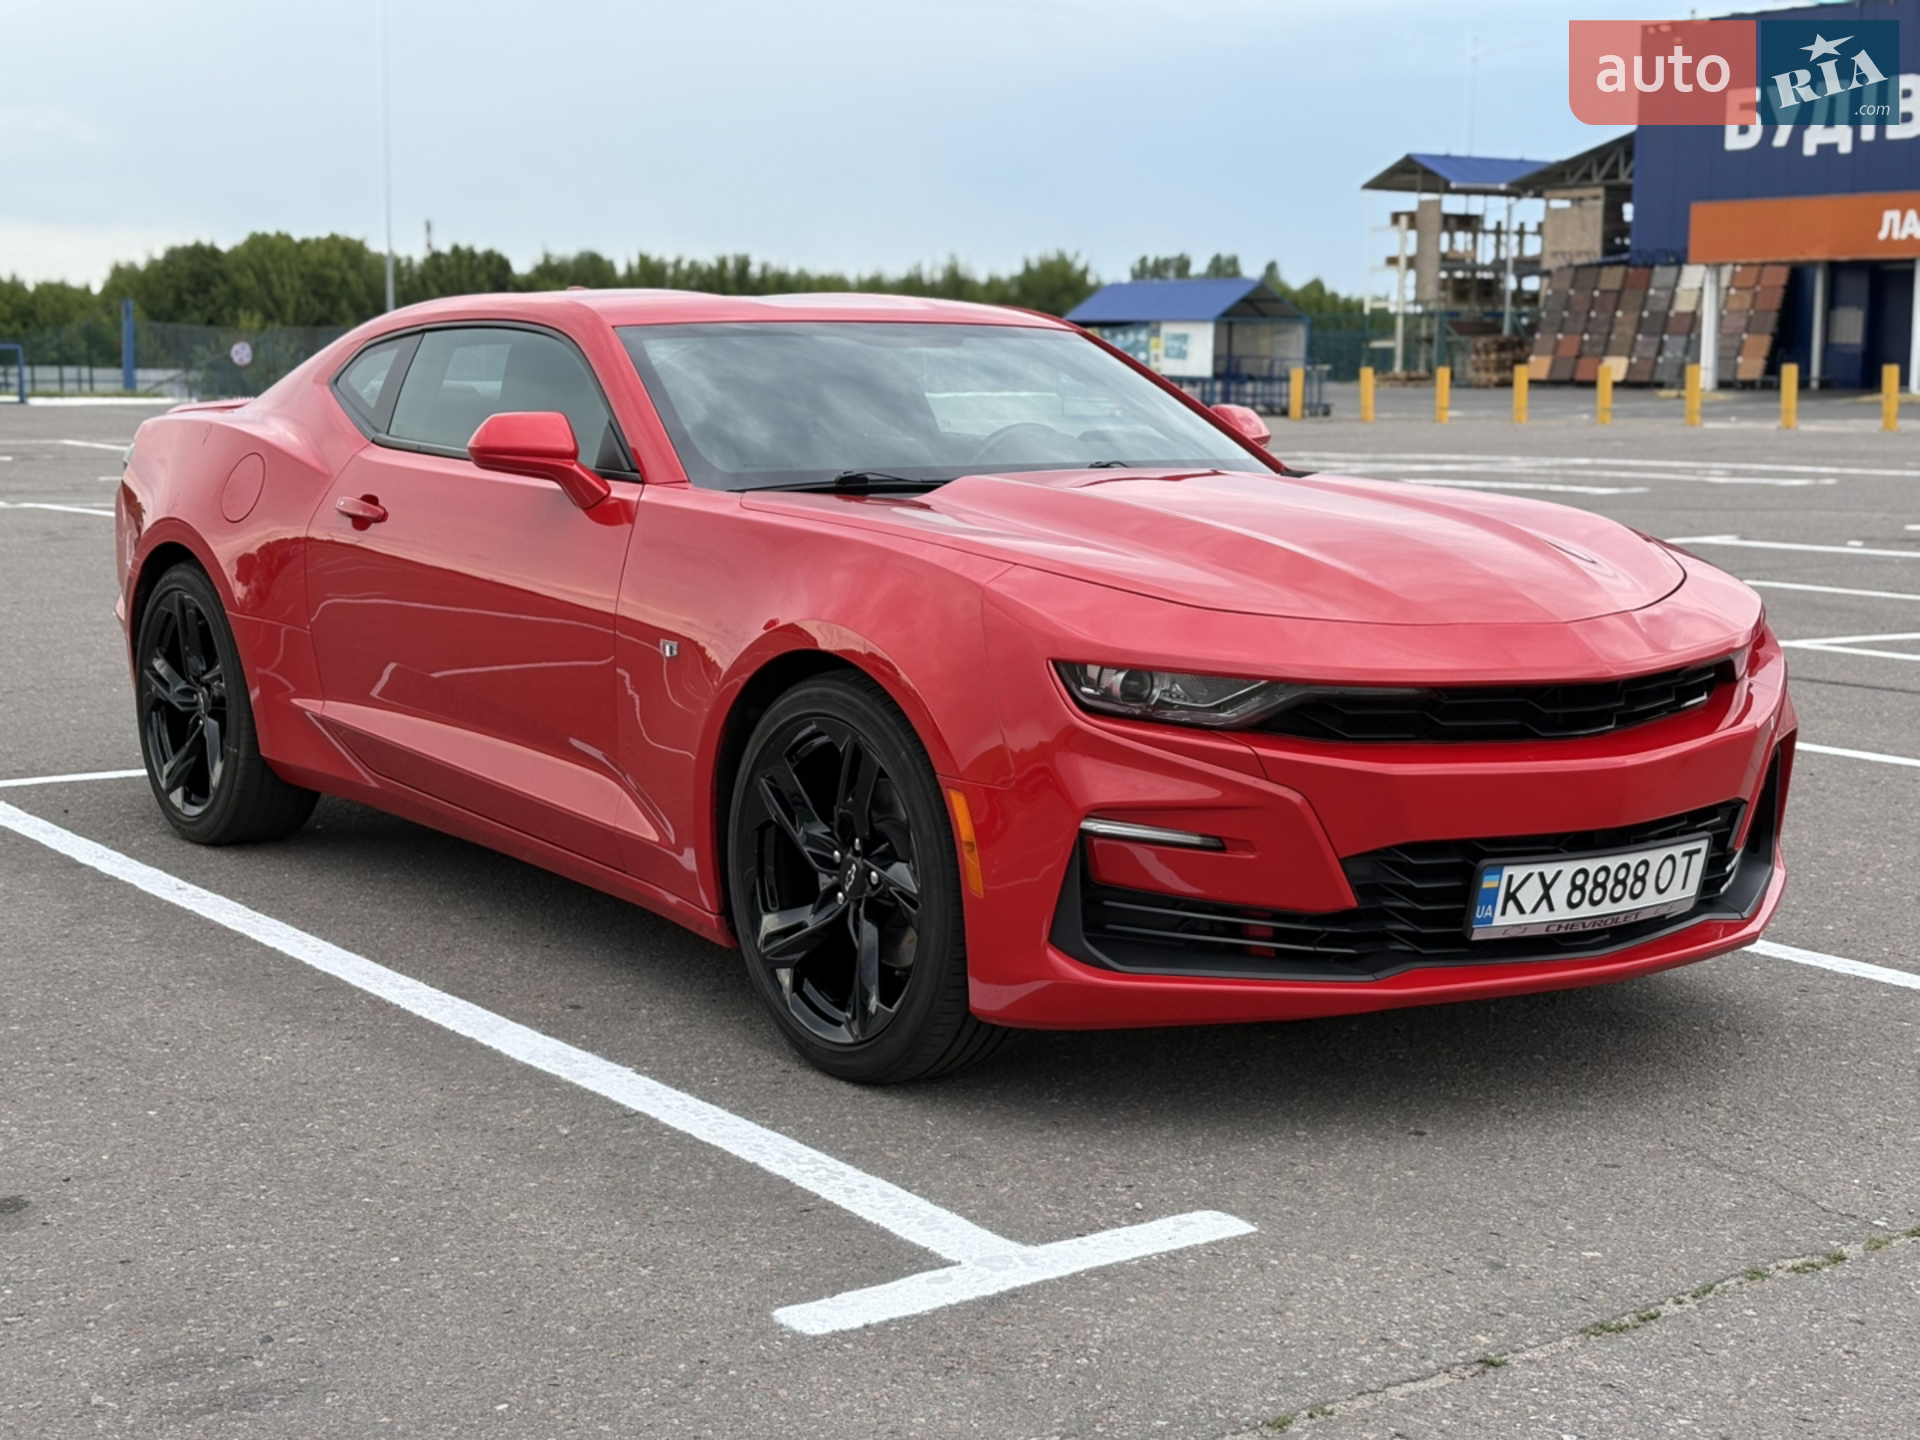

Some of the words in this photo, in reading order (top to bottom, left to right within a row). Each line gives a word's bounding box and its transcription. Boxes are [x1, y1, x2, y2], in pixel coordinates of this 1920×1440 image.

[1877, 208, 1920, 241] ЛА
[1500, 869, 1563, 917] KX
[1566, 859, 1650, 910] 8888
[1654, 847, 1702, 895] OT
[1475, 905, 1492, 919] UA
[1544, 911, 1642, 933] CHEVROLET
